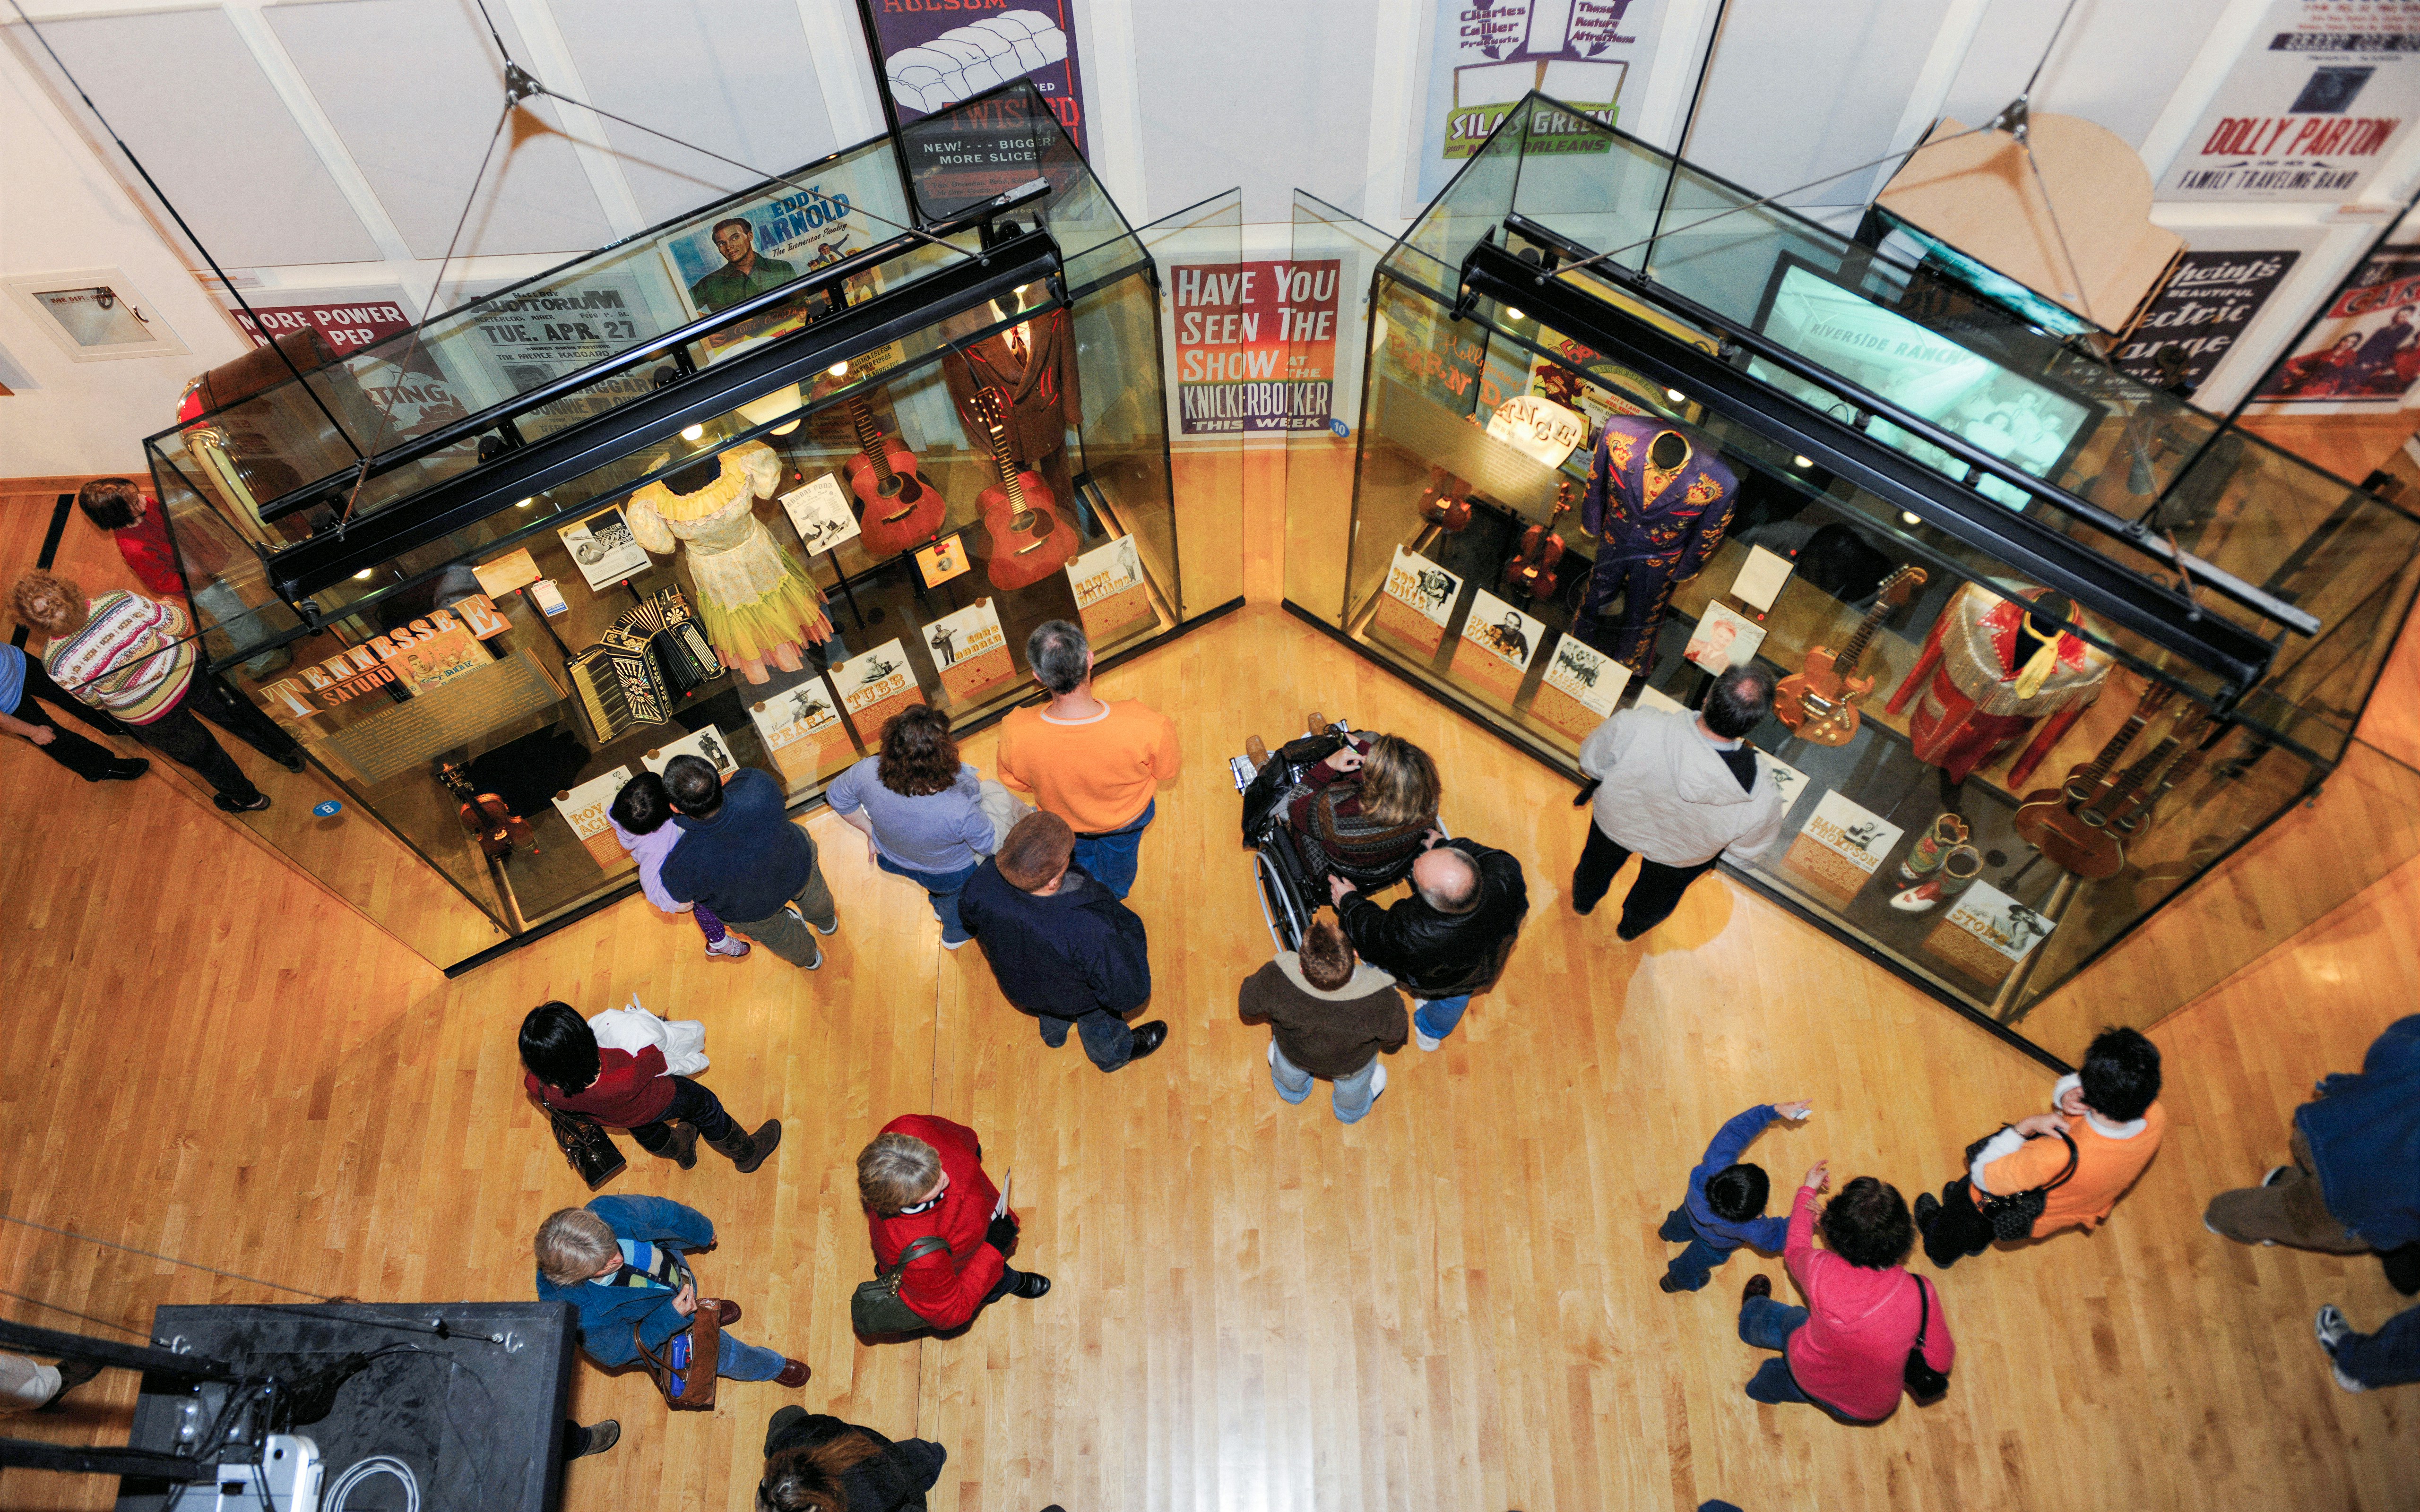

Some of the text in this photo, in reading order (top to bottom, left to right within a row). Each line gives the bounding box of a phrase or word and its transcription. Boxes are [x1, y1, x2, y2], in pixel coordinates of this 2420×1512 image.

[924, 141, 961, 153] NEW!
[2201, 118, 2401, 156] DOLLY PARTON
[940, 154, 983, 164] MORE
[2178, 171, 2233, 189] FAMILY
[769, 185, 820, 218] EDDY
[759, 193, 850, 251] ARNOLD
[772, 248, 785, 257] The
[1179, 266, 1336, 306] HAVE YOU
[2166, 289, 2255, 298] BEAUTIFUL
[470, 290, 625, 313] AUDITORIUM
[237, 306, 404, 330] MORE POWER
[1182, 308, 1333, 344] SEEN THE
[328, 329, 374, 345] PEP
[479, 321, 637, 343] TUE. APR. 27
[1810, 324, 1890, 351] RIVERSIDE
[1183, 350, 1308, 381] SHOW AT
[1285, 369, 1321, 378] THE
[1184, 382, 1328, 419] KNICKERBOCKER
[1192, 418, 1320, 430] THIS WEEK
[1333, 422, 1346, 435] 10
[259, 593, 512, 719] TENNESSEE
[845, 673, 906, 709] TUBB
[767, 710, 833, 747] PEARL
[569, 803, 604, 825] ROY
[579, 815, 611, 835] ACU
